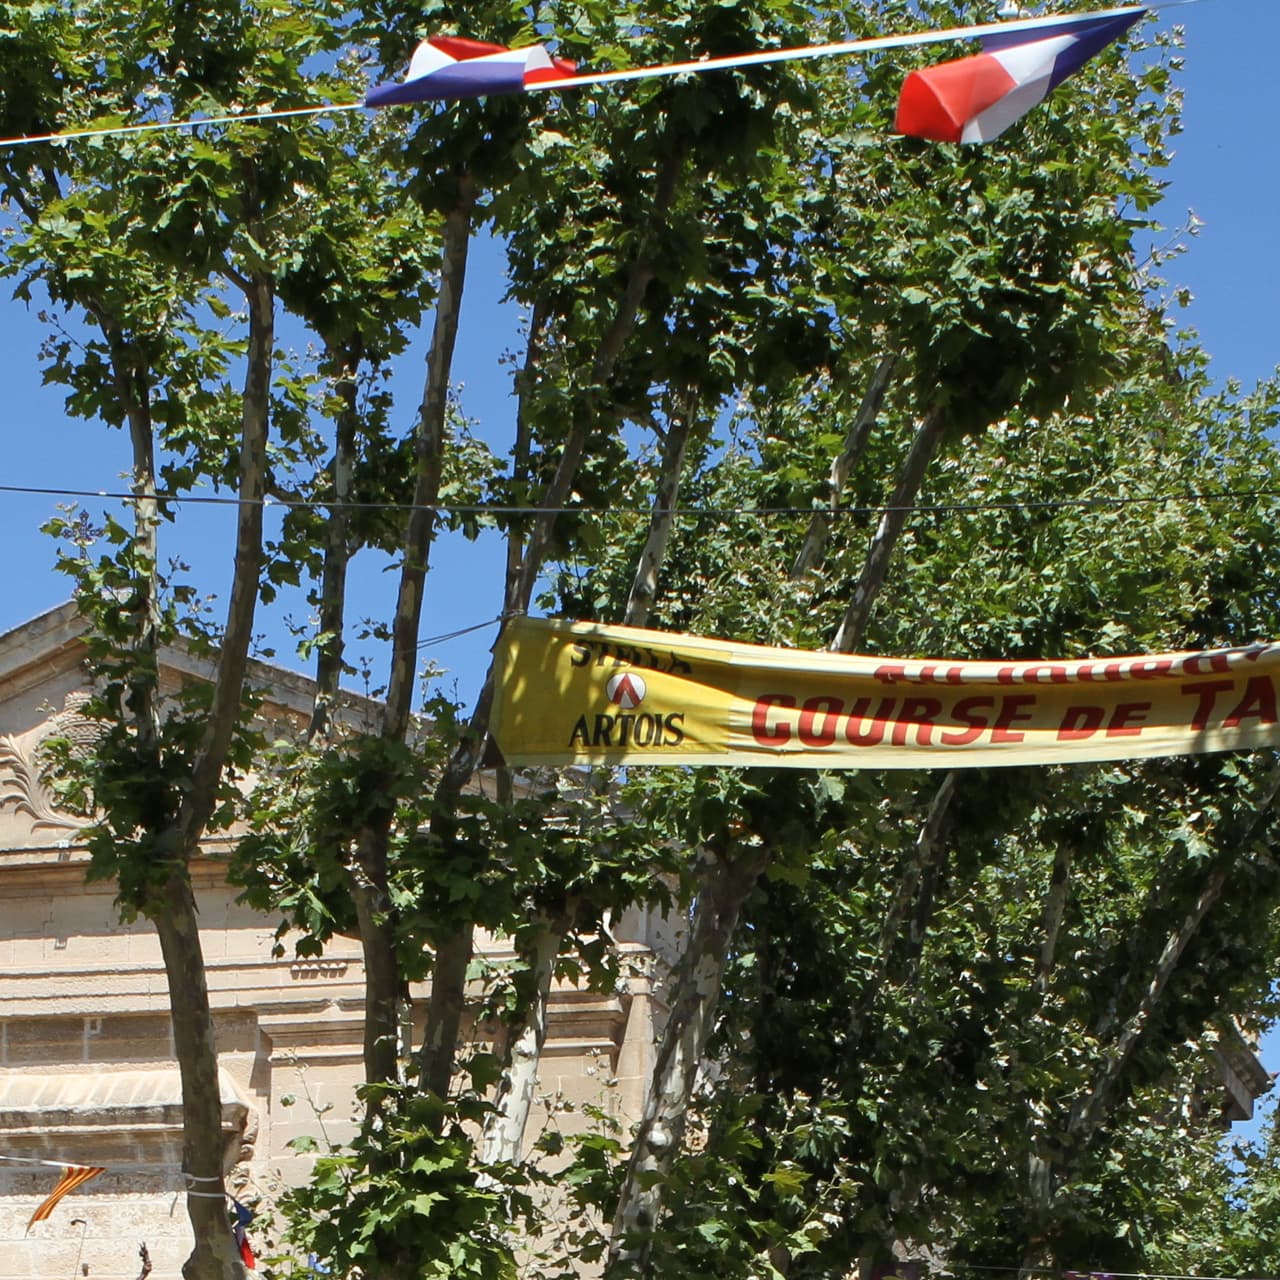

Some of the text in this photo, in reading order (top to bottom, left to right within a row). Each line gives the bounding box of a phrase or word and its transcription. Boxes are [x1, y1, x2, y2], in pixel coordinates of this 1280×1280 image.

[568, 712, 685, 748] ARTOIS
[750, 693, 1036, 748] COURSE
[1057, 700, 1152, 741] DE
